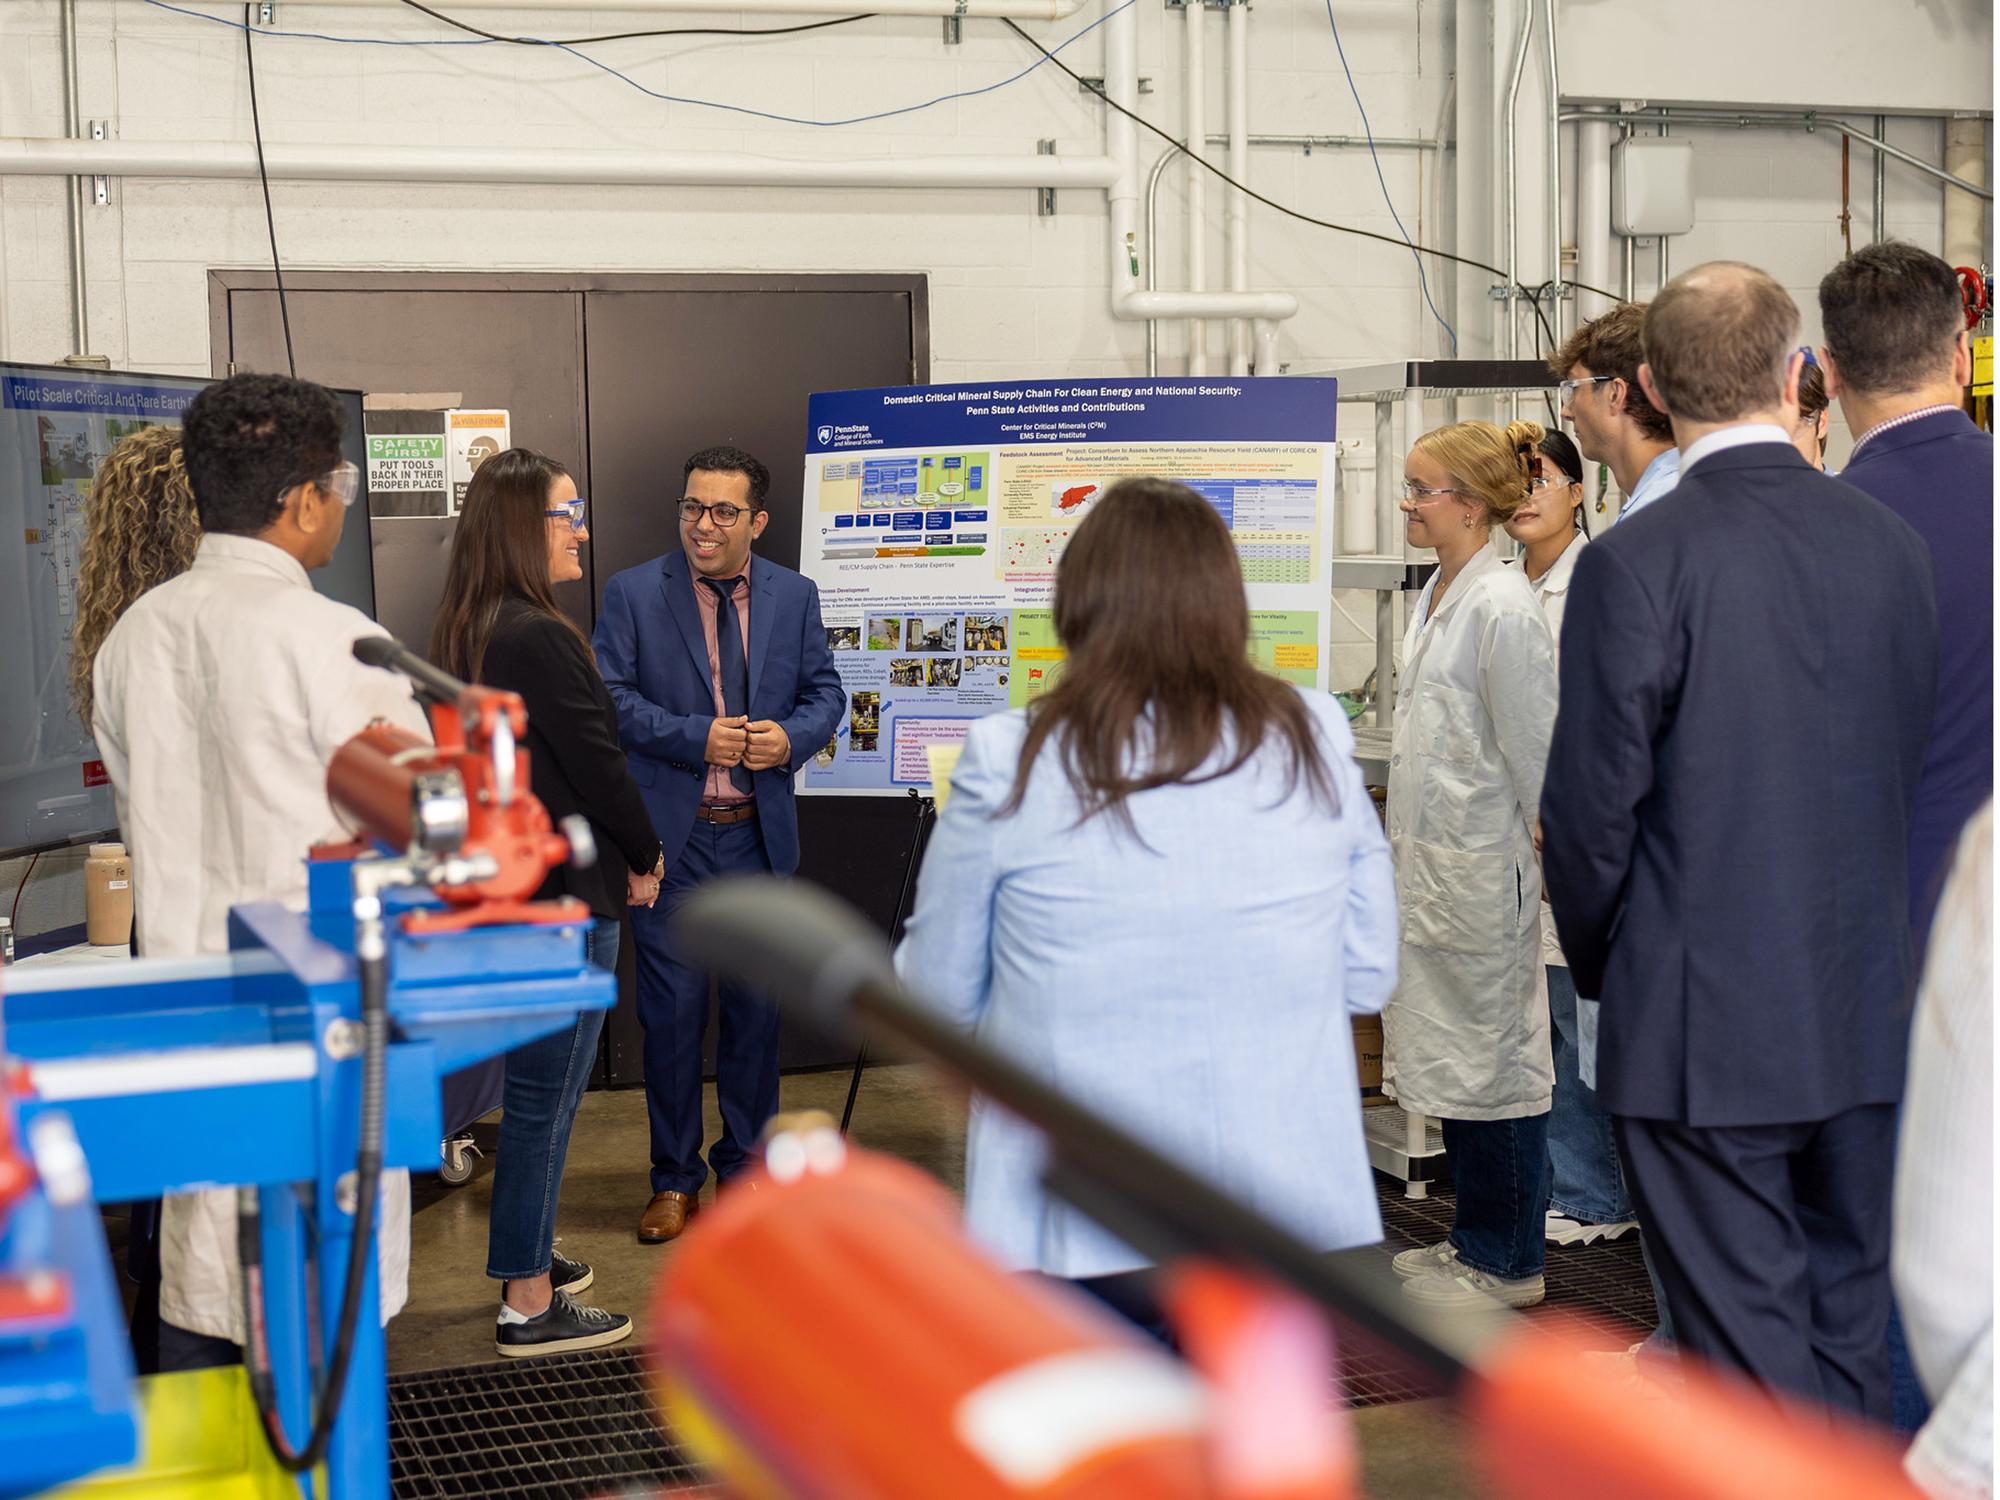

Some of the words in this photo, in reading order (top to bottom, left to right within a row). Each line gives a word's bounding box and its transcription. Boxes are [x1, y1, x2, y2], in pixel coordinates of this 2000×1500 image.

[14, 386, 40, 400] Pilot
[43, 387, 72, 403] Scale
[75, 390, 112, 406] Critical
[115, 393, 135, 407] And
[137, 394, 159, 408] Rare
[161, 396, 186, 409] Earth
[884, 395, 924, 405] Domestic
[925, 394, 956, 403] Critical
[957, 392, 991, 401] Mineral
[993, 391, 1023, 401] Supply
[1025, 389, 1051, 398] Chain
[1054, 388, 1069, 397] For
[1071, 388, 1097, 397] Clean
[1100, 387, 1132, 397] Energy
[1135, 387, 1153, 396] and
[1155, 386, 1197, 396] National
[1199, 386, 1242, 396] Security:
[966, 407, 989, 415] Penn
[991, 405, 1015, 414] State
[1017, 404, 1059, 414] Activities
[1061, 403, 1079, 412] and
[1081, 402, 1145, 412] Contributions
[461, 417, 504, 425] WARNING
[835, 425, 869, 433] PennState
[373, 439, 439, 452] SAFETY
[385, 448, 430, 457] FIRST
[380, 461, 399, 469] PUT
[402, 460, 434, 469] TOOLS
[371, 471, 398, 479] BACK
[401, 471, 411, 479] IN
[414, 470, 443, 479] THEIR
[371, 480, 409, 490] PROPER
[413, 480, 444, 489] PLACE
[116, 868, 125, 876] Fe
